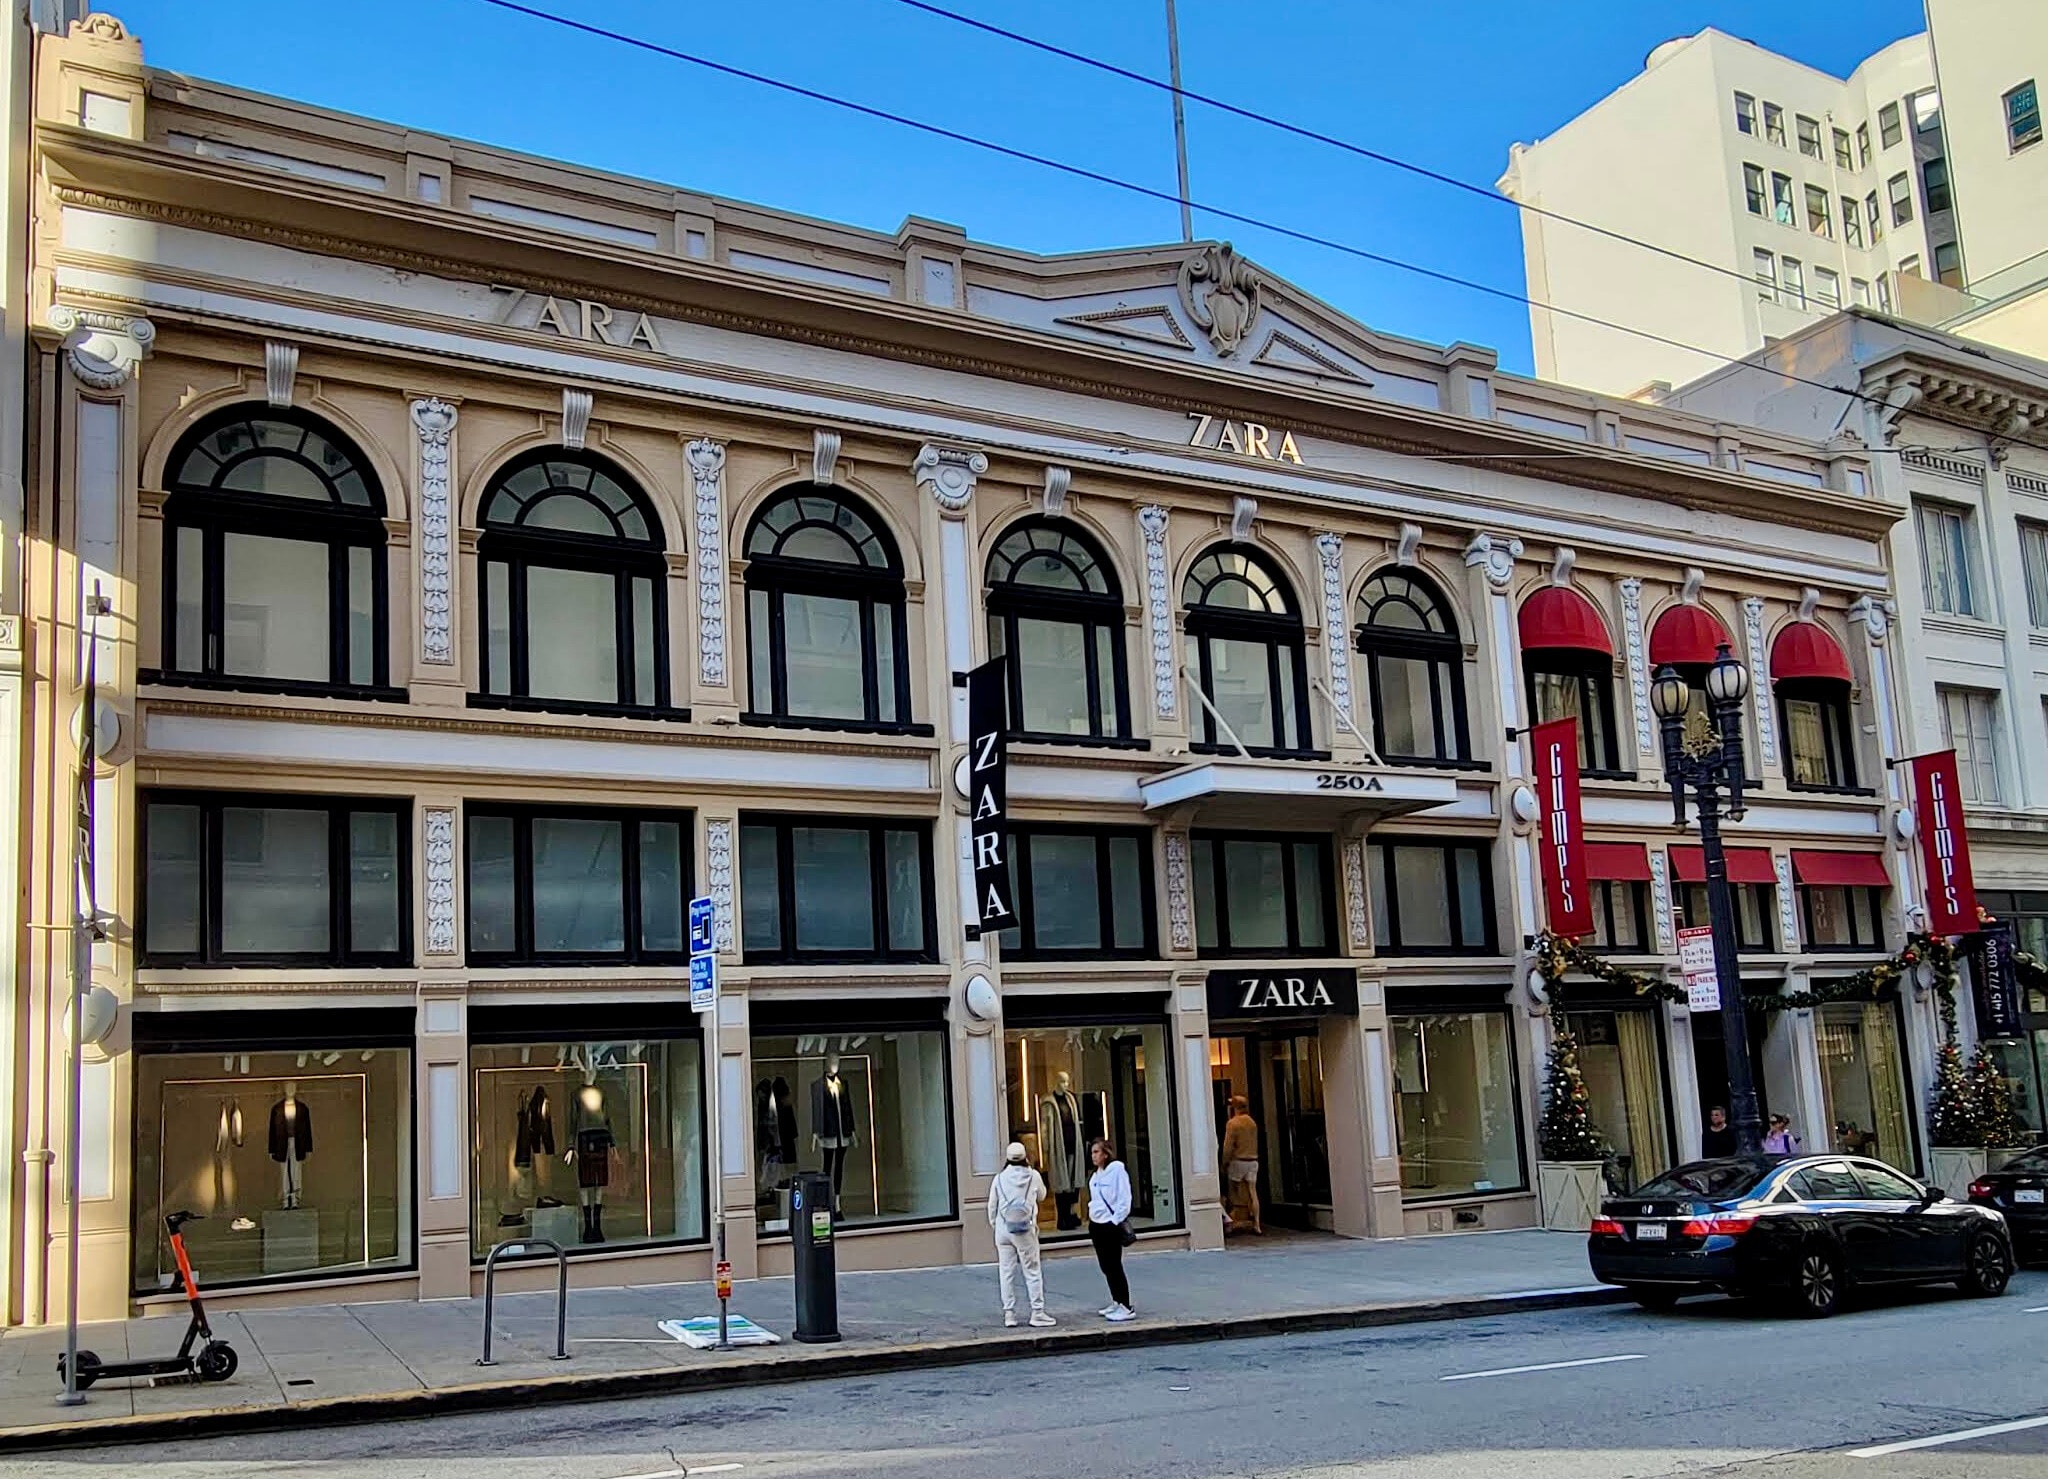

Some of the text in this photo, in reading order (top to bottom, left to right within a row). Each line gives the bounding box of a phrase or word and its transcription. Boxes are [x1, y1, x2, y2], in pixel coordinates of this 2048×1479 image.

[490, 284, 662, 352] ZARA
[1187, 411, 1306, 466] ZARA
[1317, 774, 1384, 791] 250A
[973, 731, 1010, 919] ZARA
[1550, 743, 1574, 913] GUMPS
[1930, 772, 1960, 916] GUMPS
[1985, 939, 1998, 968] 0306
[1239, 978, 1335, 1008] ZARA
[1988, 970, 2000, 990] 772
[1991, 992, 2003, 1011] 415
